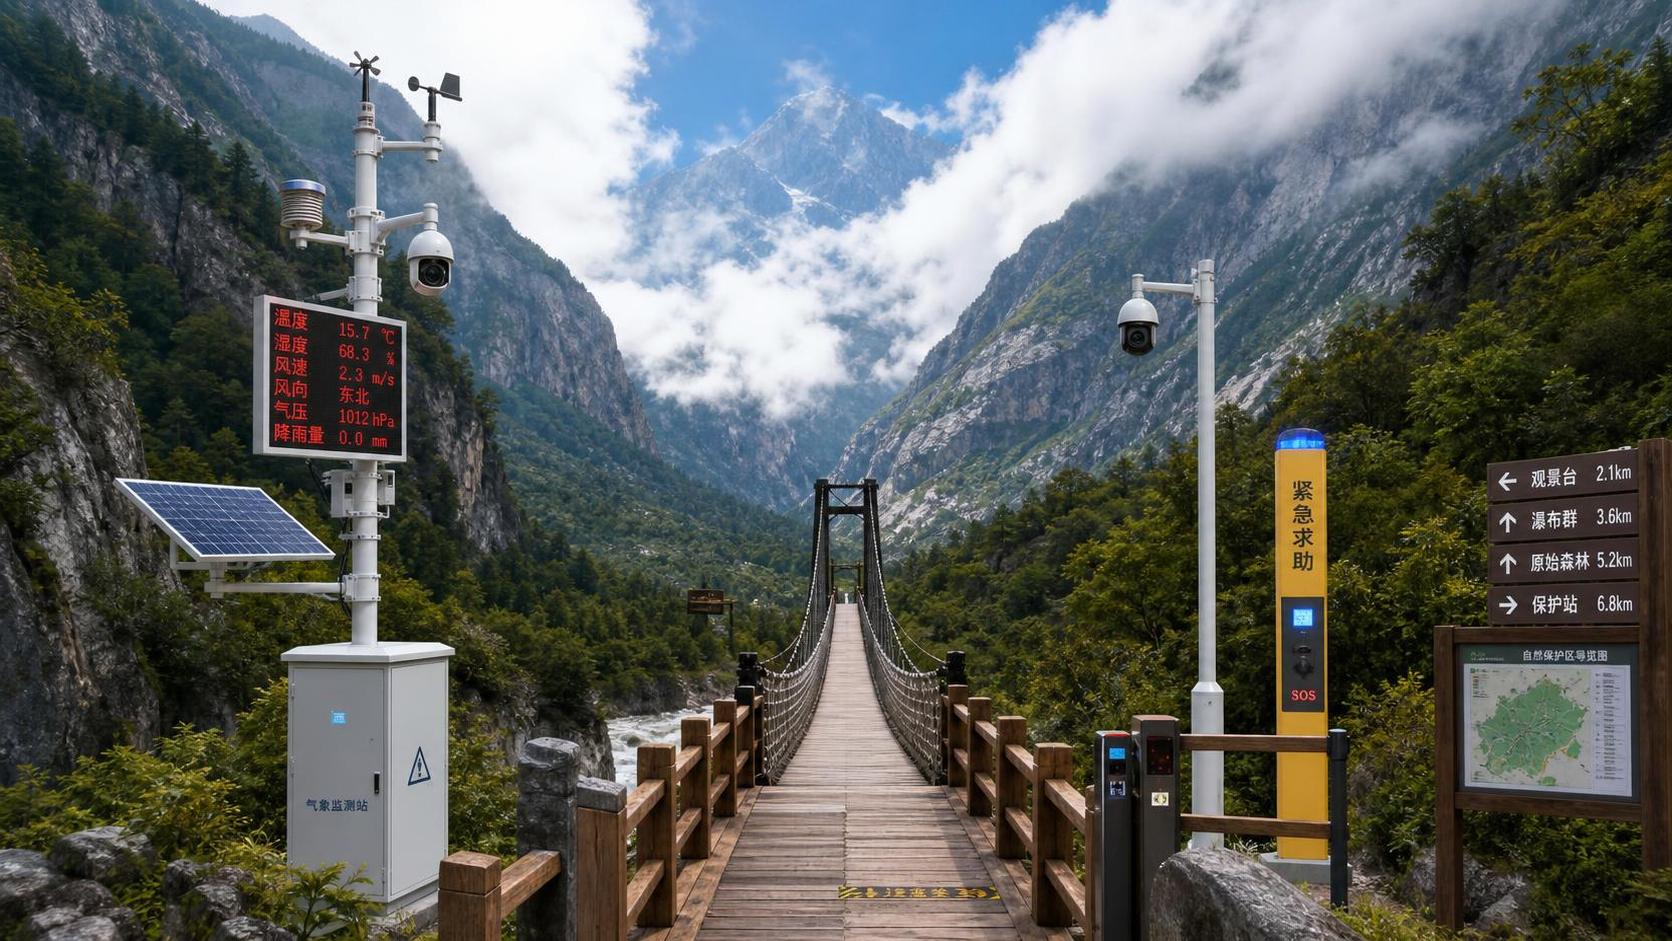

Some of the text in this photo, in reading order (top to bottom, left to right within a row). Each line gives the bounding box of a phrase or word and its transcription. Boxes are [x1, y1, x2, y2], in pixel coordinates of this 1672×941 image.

[274, 308, 309, 331] 温度
[339, 322, 370, 340] 15.7
[274, 333, 395, 367] 湿度 68.3 %
[274, 356, 395, 386] 风速 2.3 m/s
[274, 378, 370, 405] 风向 东北
[274, 400, 395, 428] 气压 1012 hPa
[274, 424, 388, 448] 降雨量 0.0 mm
[1531, 464, 1632, 488] 观景台 2.1km
[1292, 480, 1314, 572] 紧急求助
[1531, 507, 1632, 530] 瀑布群 3.6km
[1530, 551, 1633, 572] 原始森林 5.2km
[1532, 595, 1633, 614] 保护站 6.8km
[1522, 650, 1608, 662] 自然保护区导览图
[1291, 689, 1317, 701] SOS
[306, 798, 368, 812] 气象监测站
